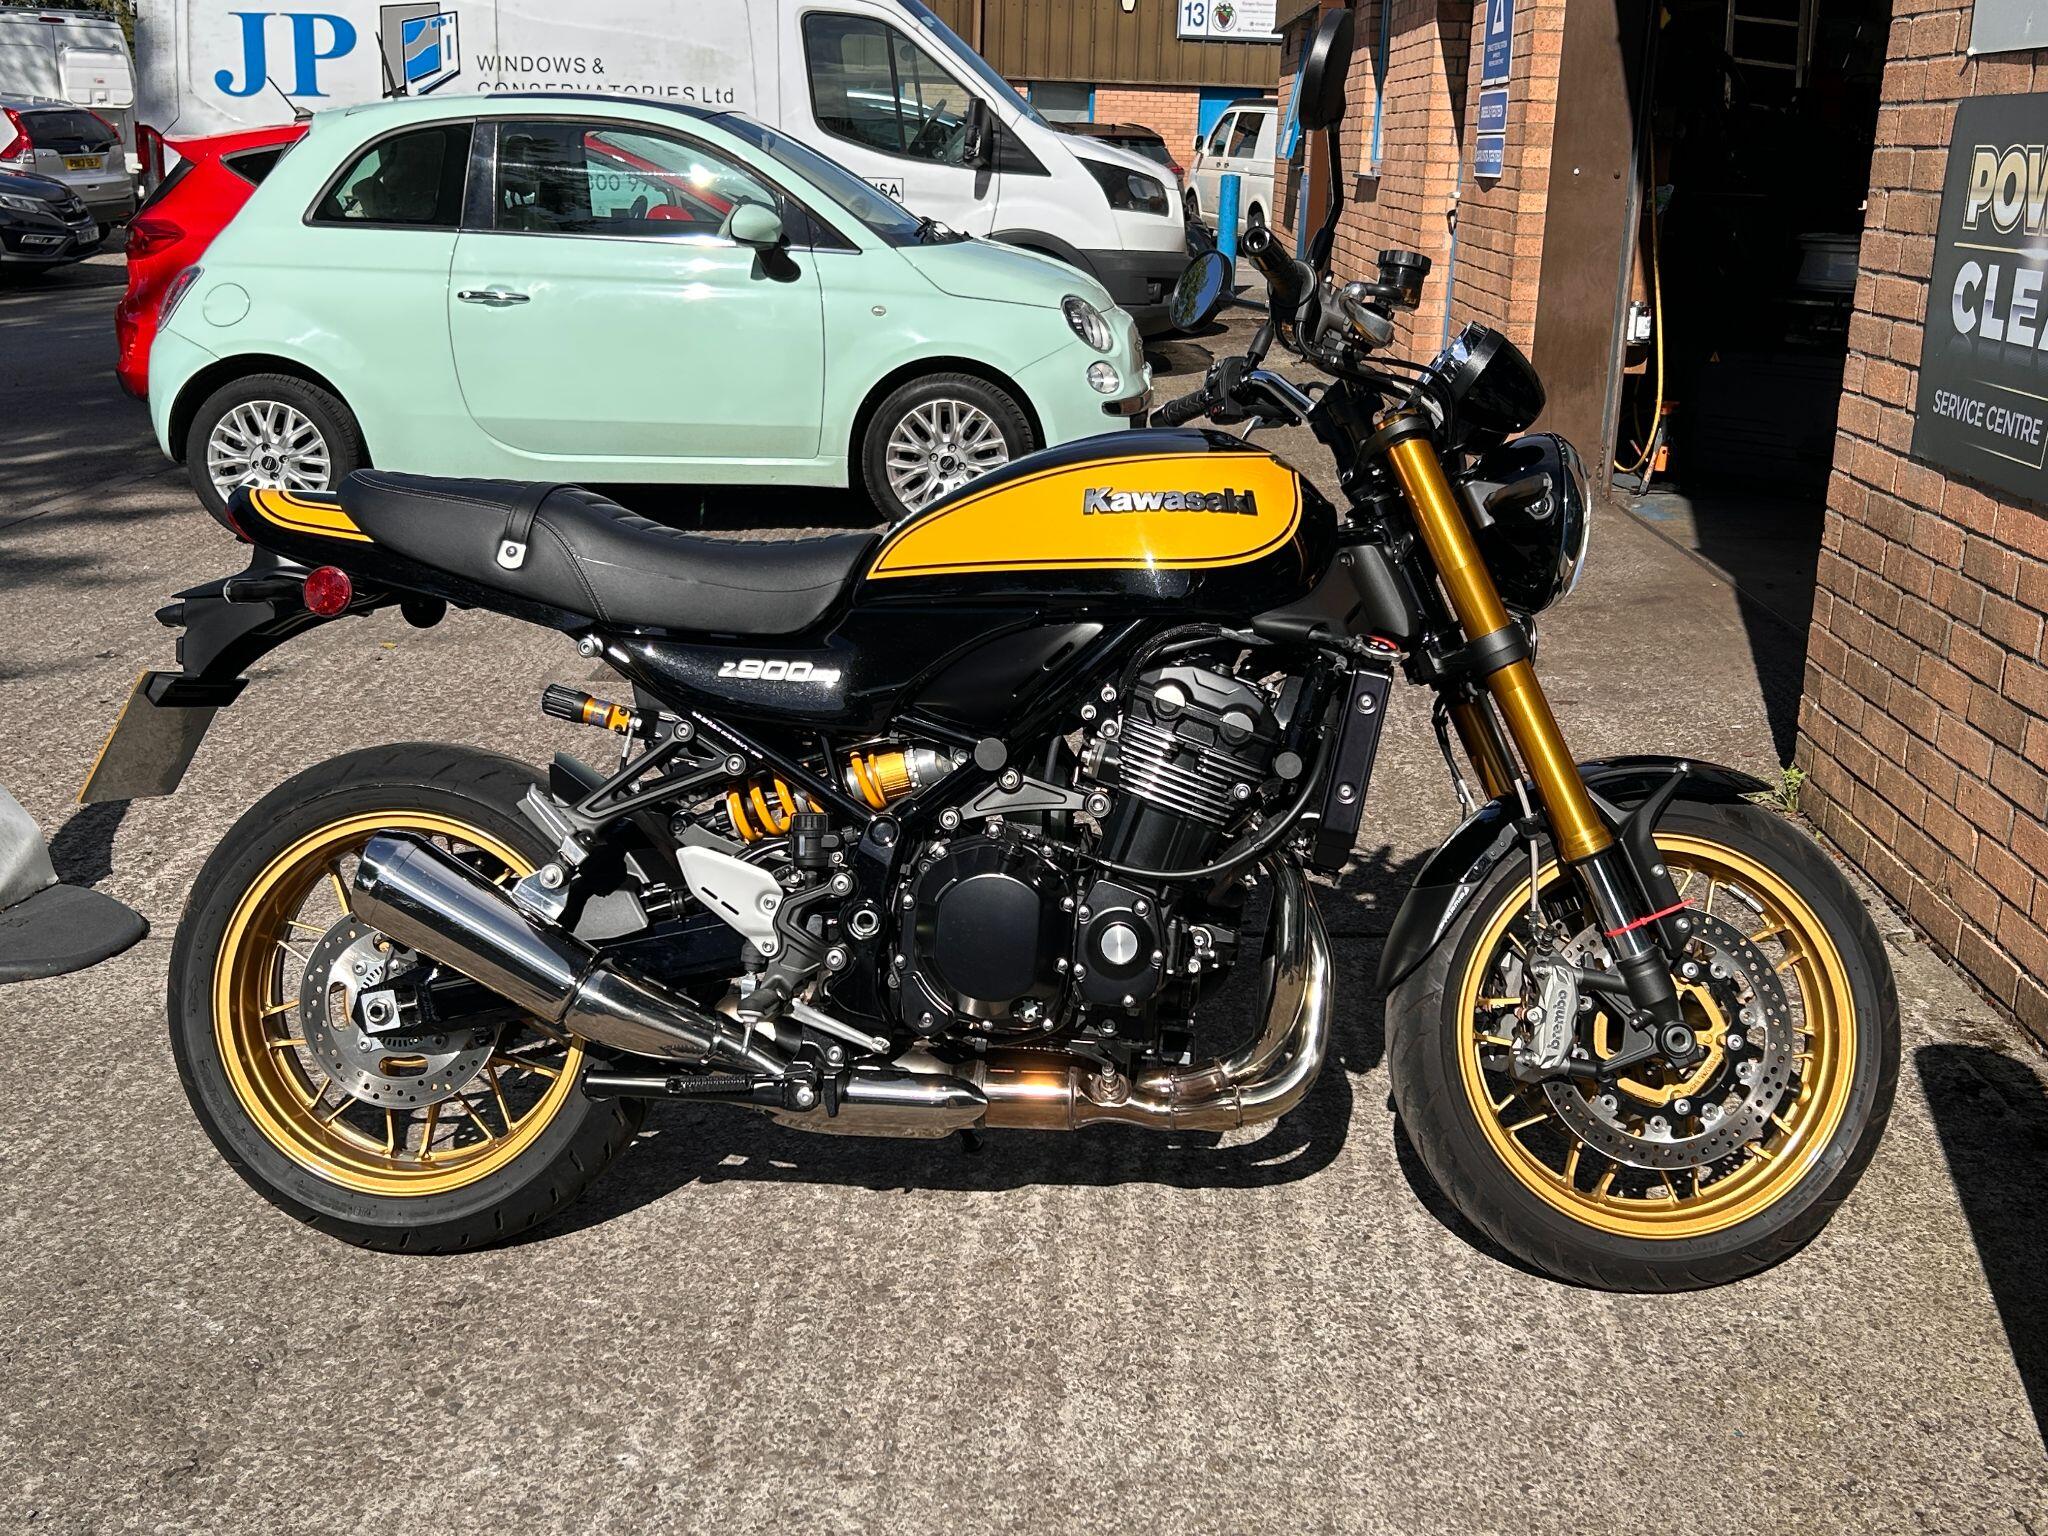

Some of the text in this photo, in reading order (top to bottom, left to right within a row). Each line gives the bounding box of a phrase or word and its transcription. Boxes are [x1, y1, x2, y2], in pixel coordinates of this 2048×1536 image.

[1184, 2, 1205, 27] 13
[214, 12, 358, 97] JP
[476, 55, 605, 74] WINDOWS &
[702, 86, 734, 103] Ltd
[874, 182, 900, 197] SA
[1952, 261, 2048, 351] CLE
[1932, 389, 2043, 446] SERVICE CENTRE
[1083, 487, 1258, 516] Kawasaki
[1546, 989, 1568, 1050] brembo
